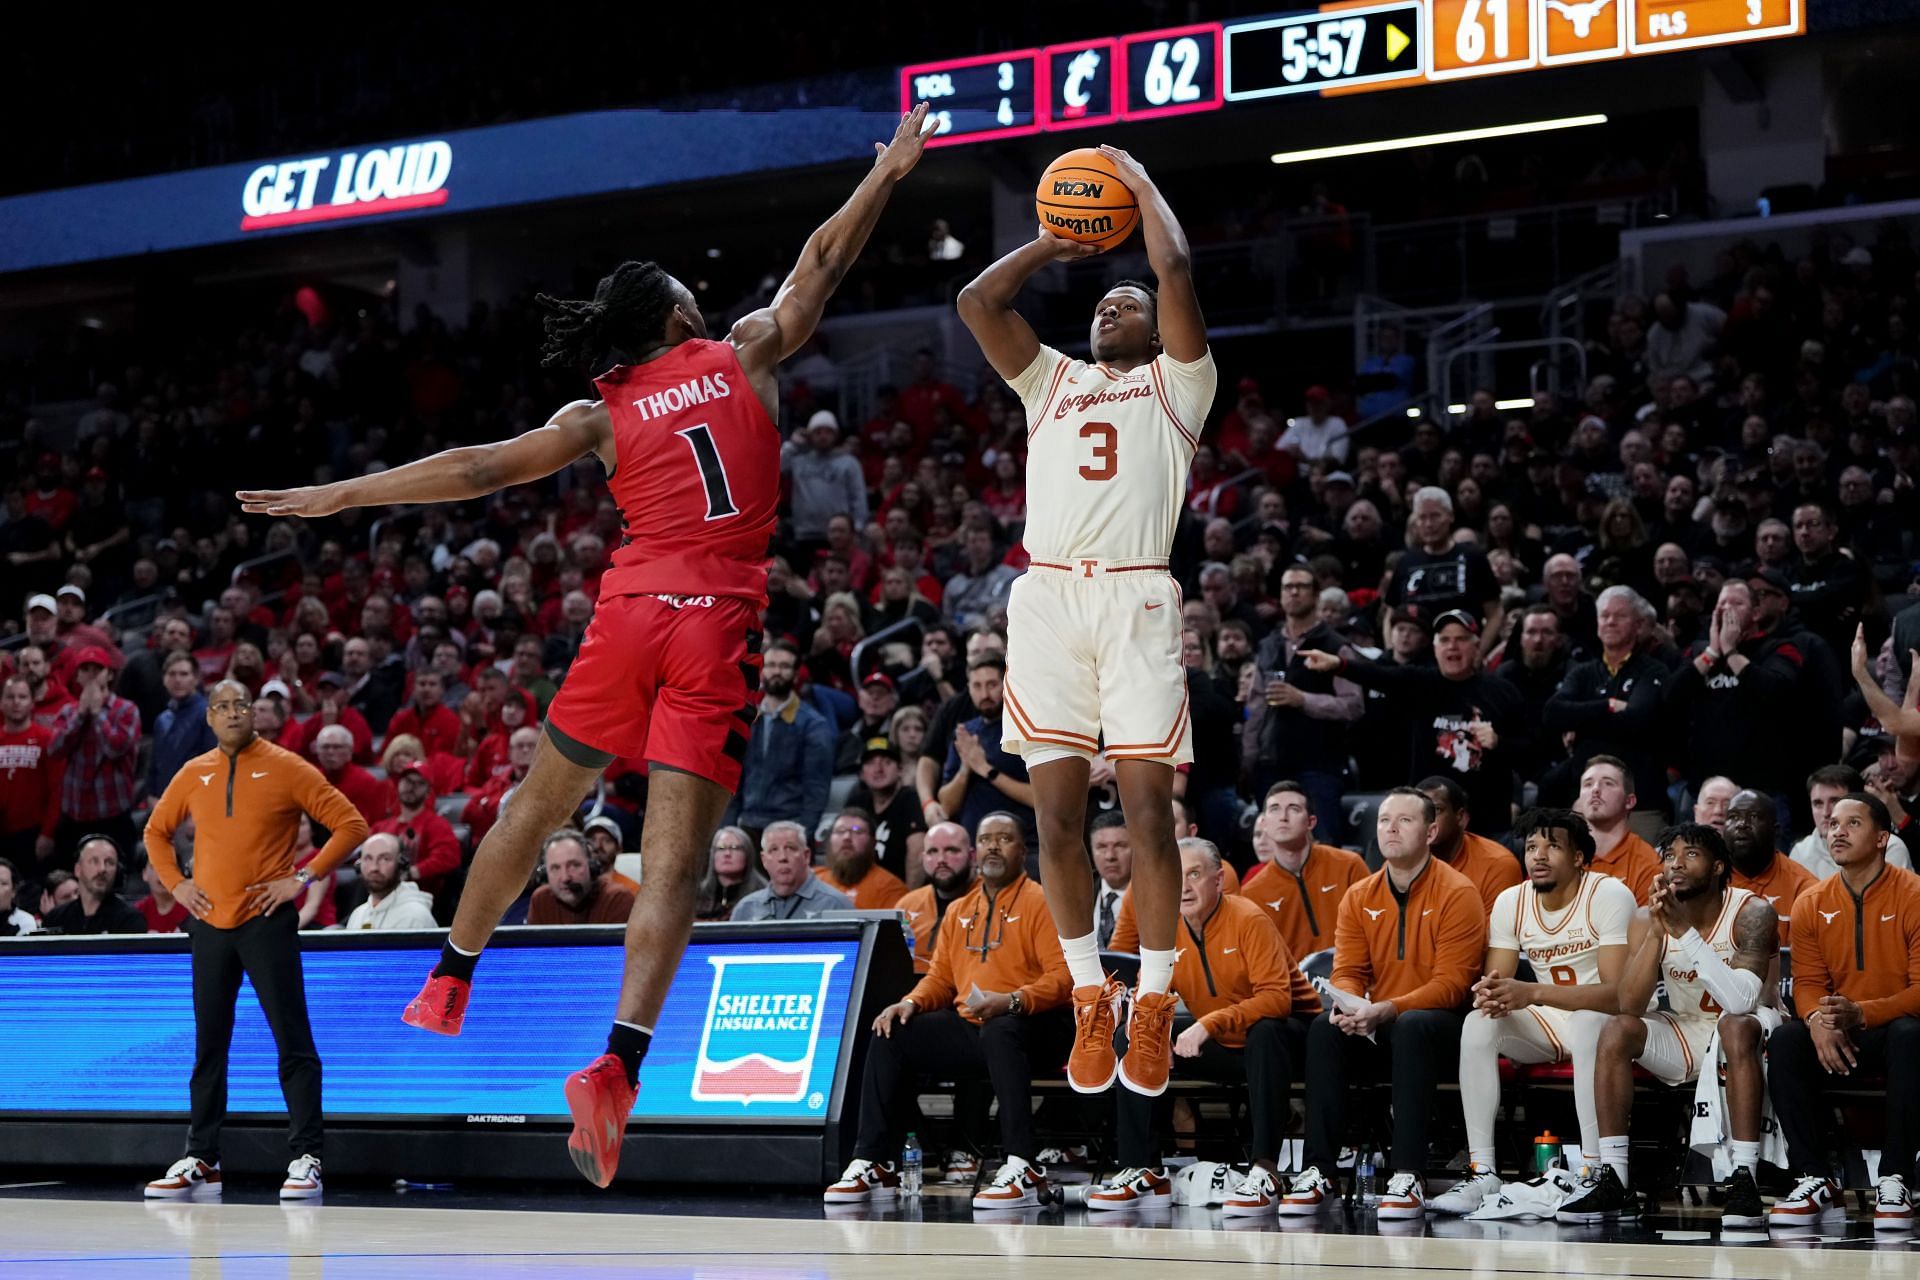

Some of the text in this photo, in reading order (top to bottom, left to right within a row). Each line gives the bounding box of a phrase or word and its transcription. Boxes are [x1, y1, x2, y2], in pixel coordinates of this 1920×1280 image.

[1456, 0, 1509, 63] 61
[1649, 11, 1687, 37] FLS
[1281, 18, 1366, 82] 5:57
[914, 62, 1014, 99] TOL 3
[1144, 37, 1200, 105] 62
[242, 140, 453, 217] GET LOUD
[1053, 181, 1104, 199] NCAA
[1045, 211, 1113, 235] Wilson
[633, 372, 731, 421] THOMAS
[1053, 384, 1154, 422] Longhorns
[1079, 422, 1118, 481] 3
[674, 423, 740, 522] 1
[1081, 560, 1098, 577] T
[1526, 939, 1593, 963] Longhorns
[718, 994, 813, 1015] SHELTER
[714, 1016, 809, 1031] INSURANCE
[467, 1115, 526, 1123] DAKTRONICS
